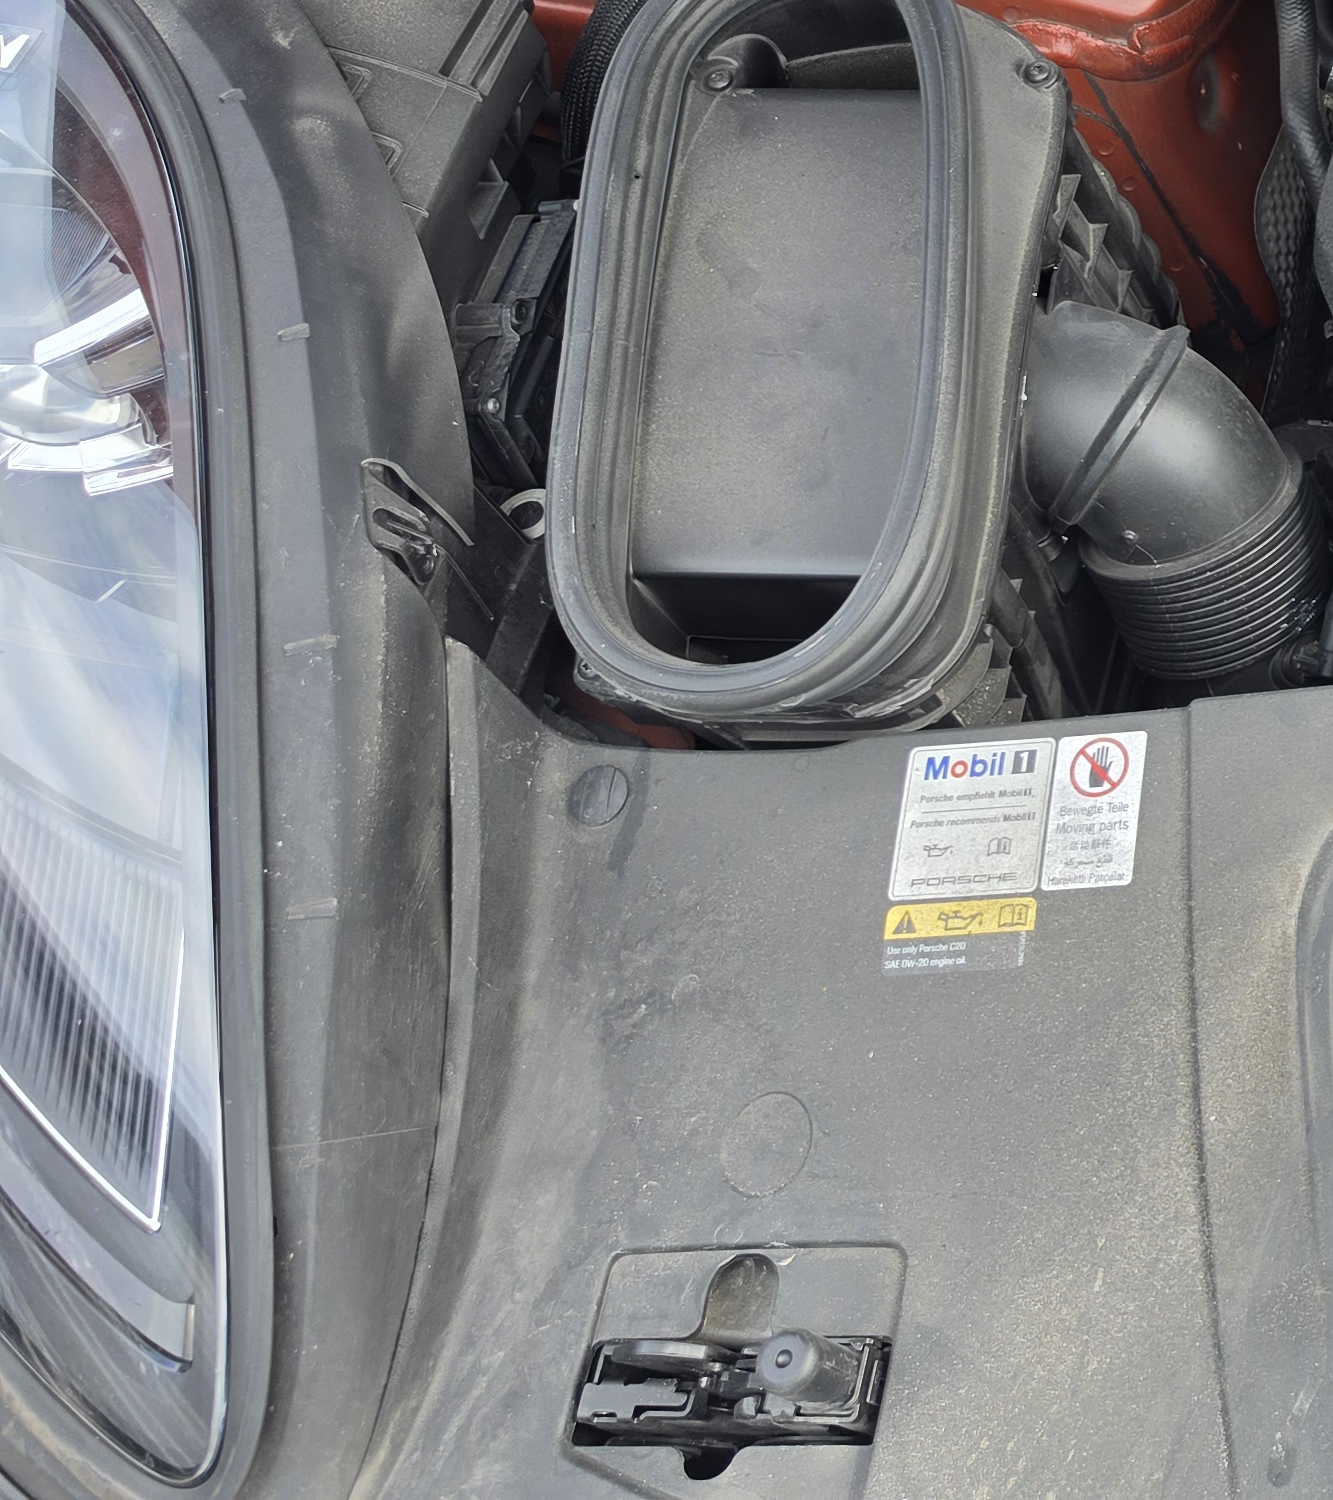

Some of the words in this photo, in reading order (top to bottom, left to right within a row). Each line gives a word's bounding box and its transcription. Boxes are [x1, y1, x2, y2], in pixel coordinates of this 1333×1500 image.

[924, 752, 1006, 781] Mobil
[920, 792, 954, 804] Porsche
[957, 791, 995, 802] empfiehlt
[998, 788, 1022, 798] Mobil
[1060, 804, 1103, 817] Bewegte
[1107, 802, 1129, 813] Teile
[910, 818, 944, 829] Porsche
[946, 815, 1001, 827] recommends
[1002, 813, 1026, 822] Mobil
[1056, 822, 1096, 835] Moving
[1099, 819, 1129, 832] parts
[911, 872, 1018, 888] PORSCHE
[887, 945, 901, 955] Use
[902, 944, 917, 956] only
[919, 943, 948, 953] Porsche
[950, 941, 966, 950] C20
[884, 960, 900, 970] SAE
[901, 958, 929, 968] 0W-20
[930, 957, 955, 967] engine
